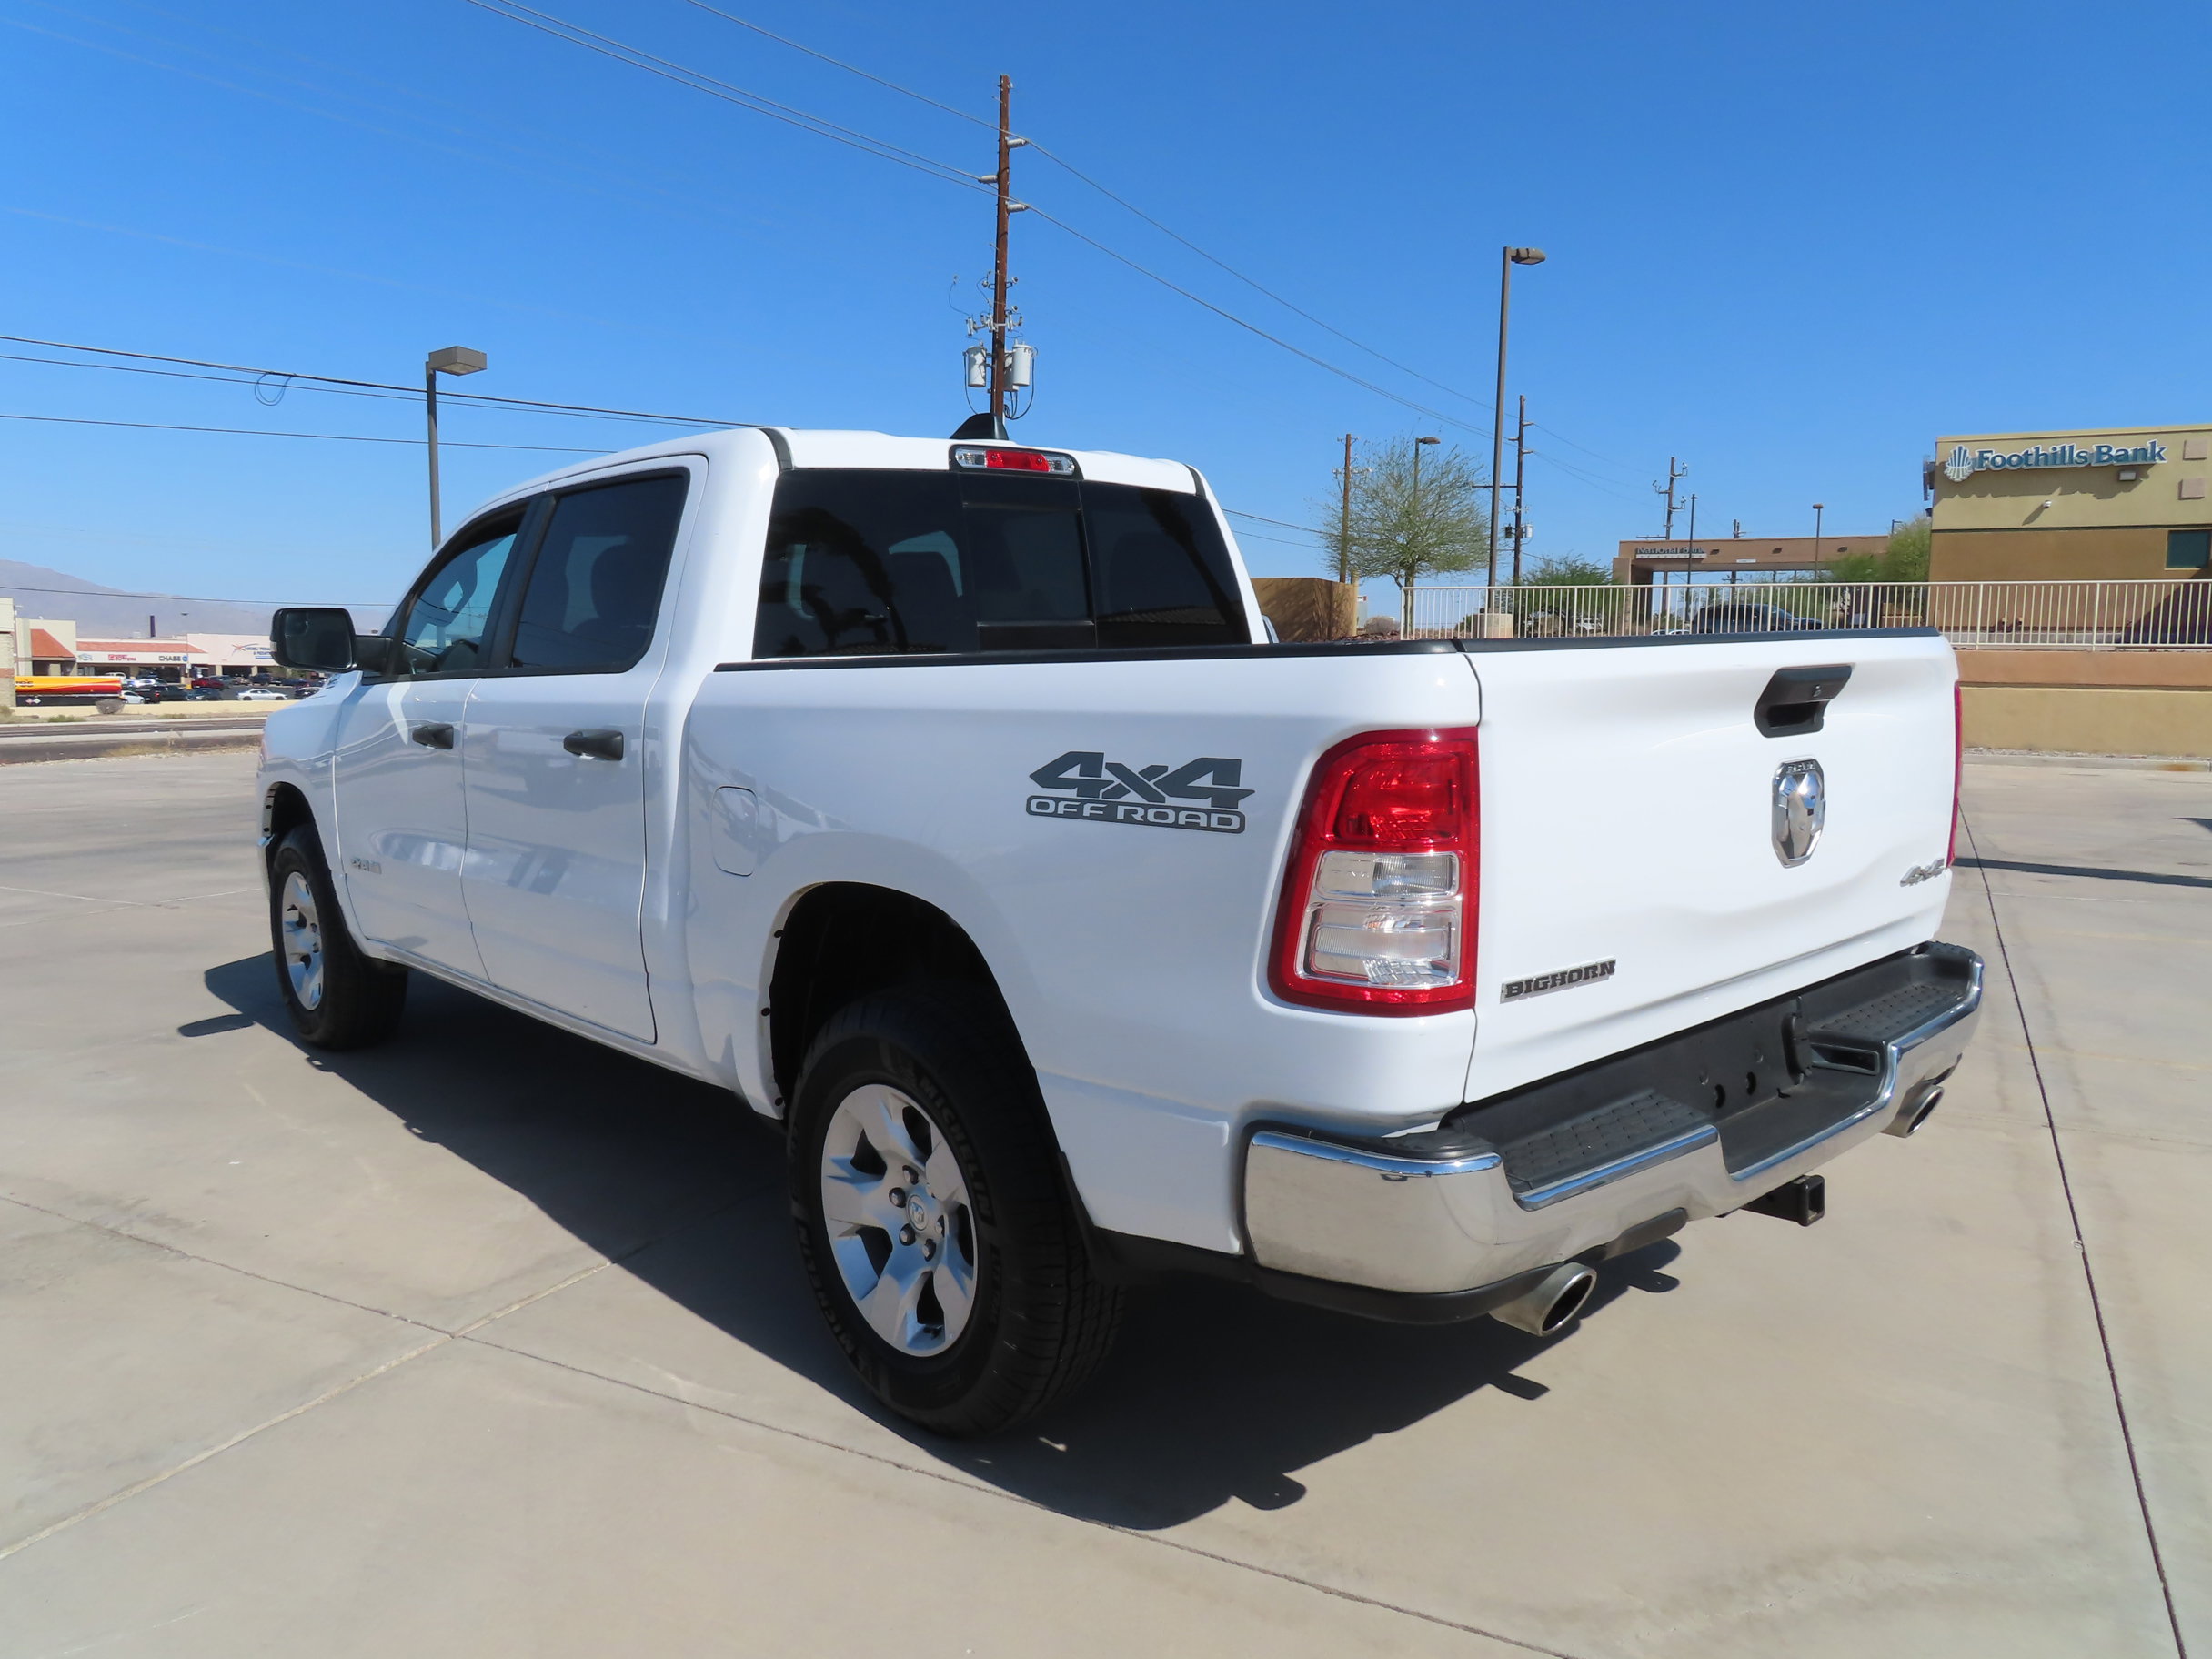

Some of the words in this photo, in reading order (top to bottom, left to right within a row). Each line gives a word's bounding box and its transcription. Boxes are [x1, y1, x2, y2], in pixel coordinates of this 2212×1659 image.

[1976, 444, 2090, 470] Foothills
[2094, 439, 2167, 464] Bank
[1029, 751, 1255, 809] 4x4
[1030, 798, 1107, 817] OFF
[1116, 805, 1241, 830] ROAD
[1504, 959, 1616, 999] BIGHORN
